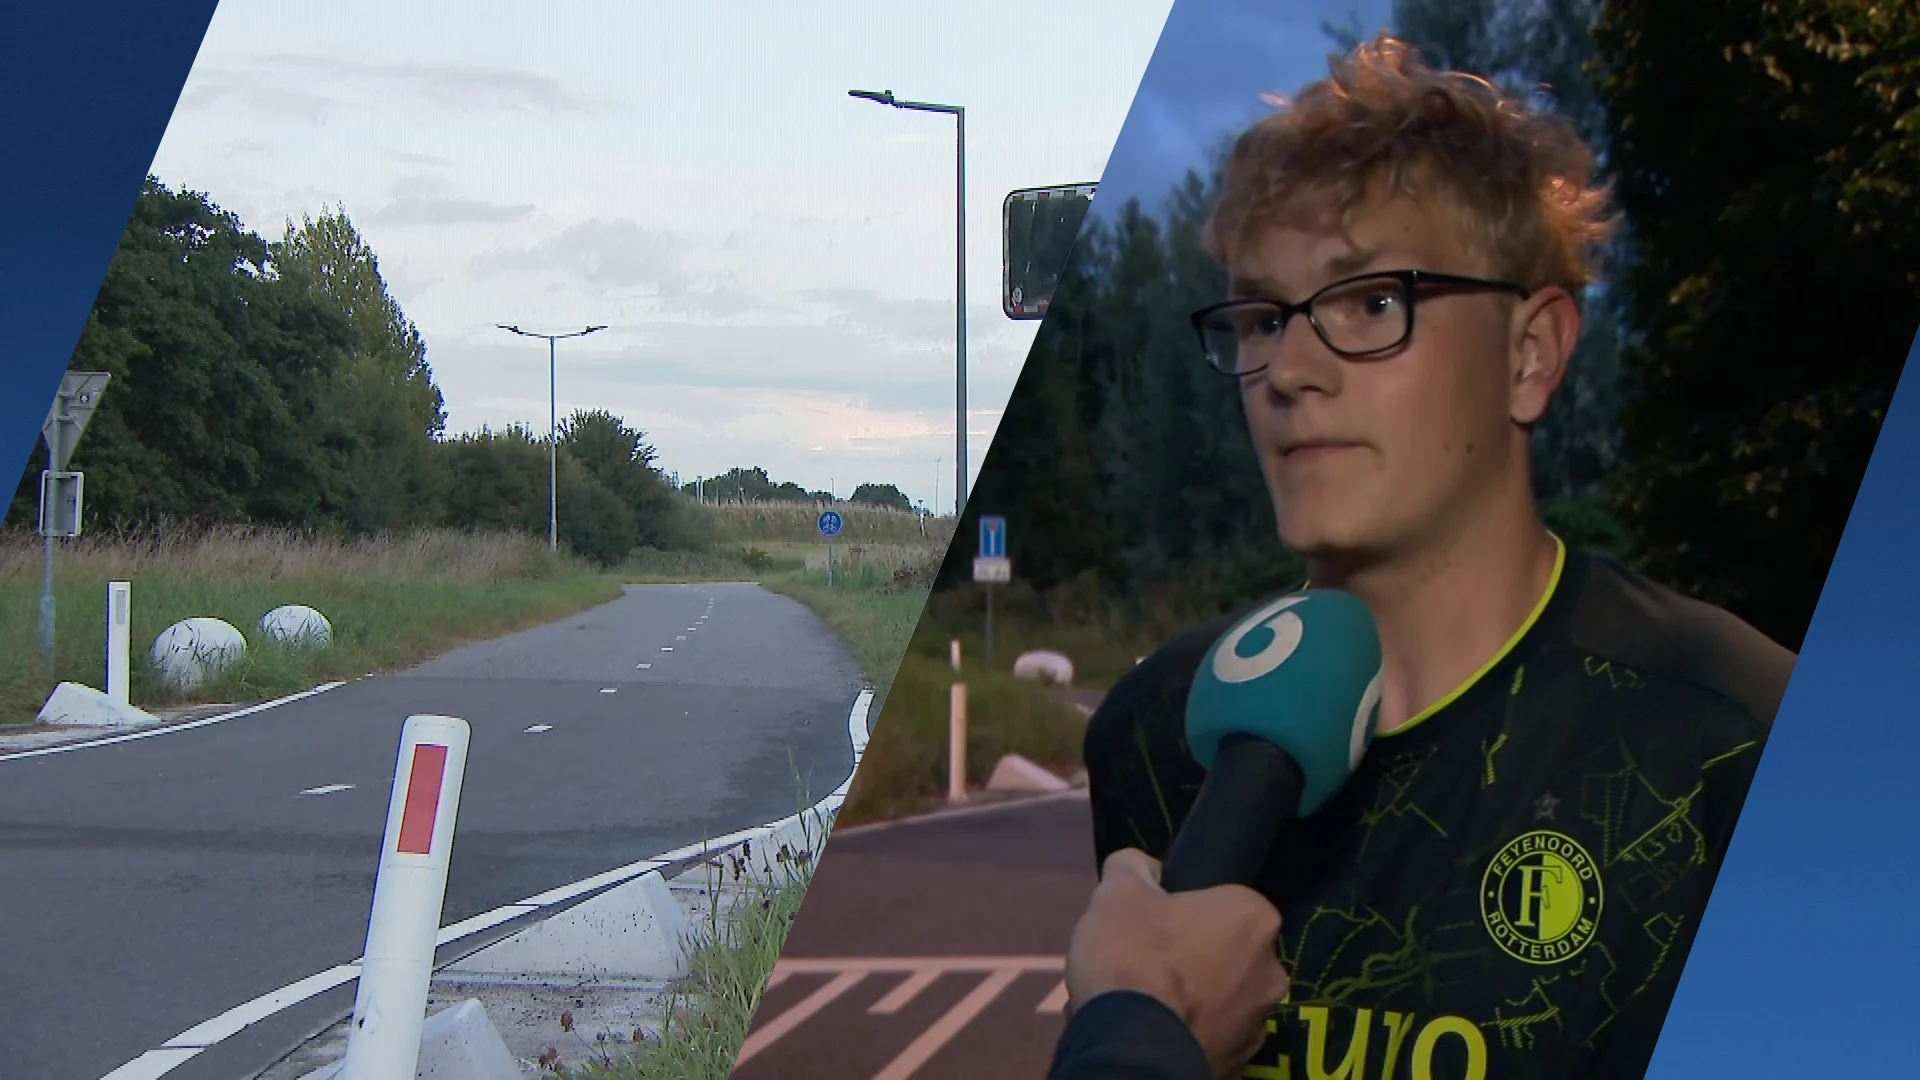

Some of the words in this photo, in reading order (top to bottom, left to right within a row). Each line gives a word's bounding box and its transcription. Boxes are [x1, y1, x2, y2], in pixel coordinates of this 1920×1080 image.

[1212, 596, 1311, 684] 6
[1492, 835, 1594, 881] FEYENOORD
[1487, 910, 1595, 960] ROTTERDAM
